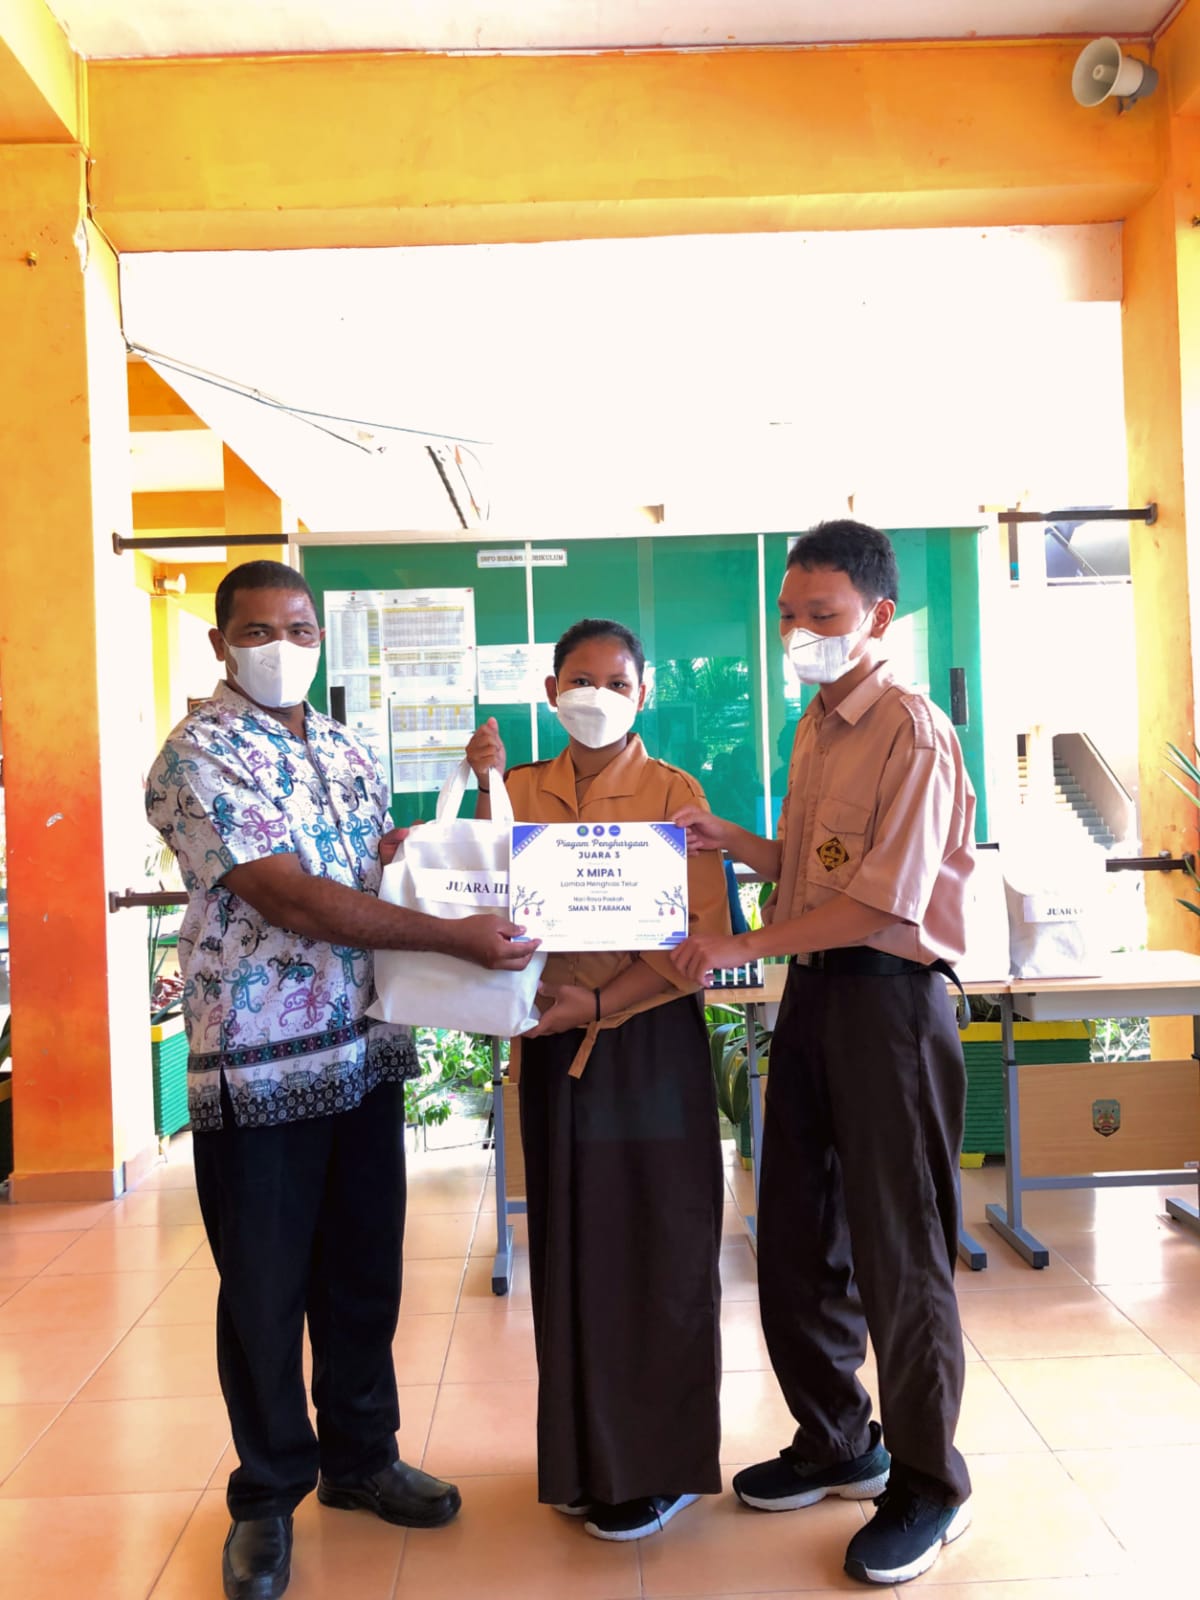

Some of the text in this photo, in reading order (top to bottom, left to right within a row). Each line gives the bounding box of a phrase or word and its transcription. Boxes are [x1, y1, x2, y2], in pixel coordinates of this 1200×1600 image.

[556, 838, 649, 850] Piagam Penghargaan
[578, 851, 620, 859] JUARA 3
[576, 868, 622, 877] X MIPA 1
[446, 881, 509, 894] JUARA III
[586, 881, 620, 889] Menghias
